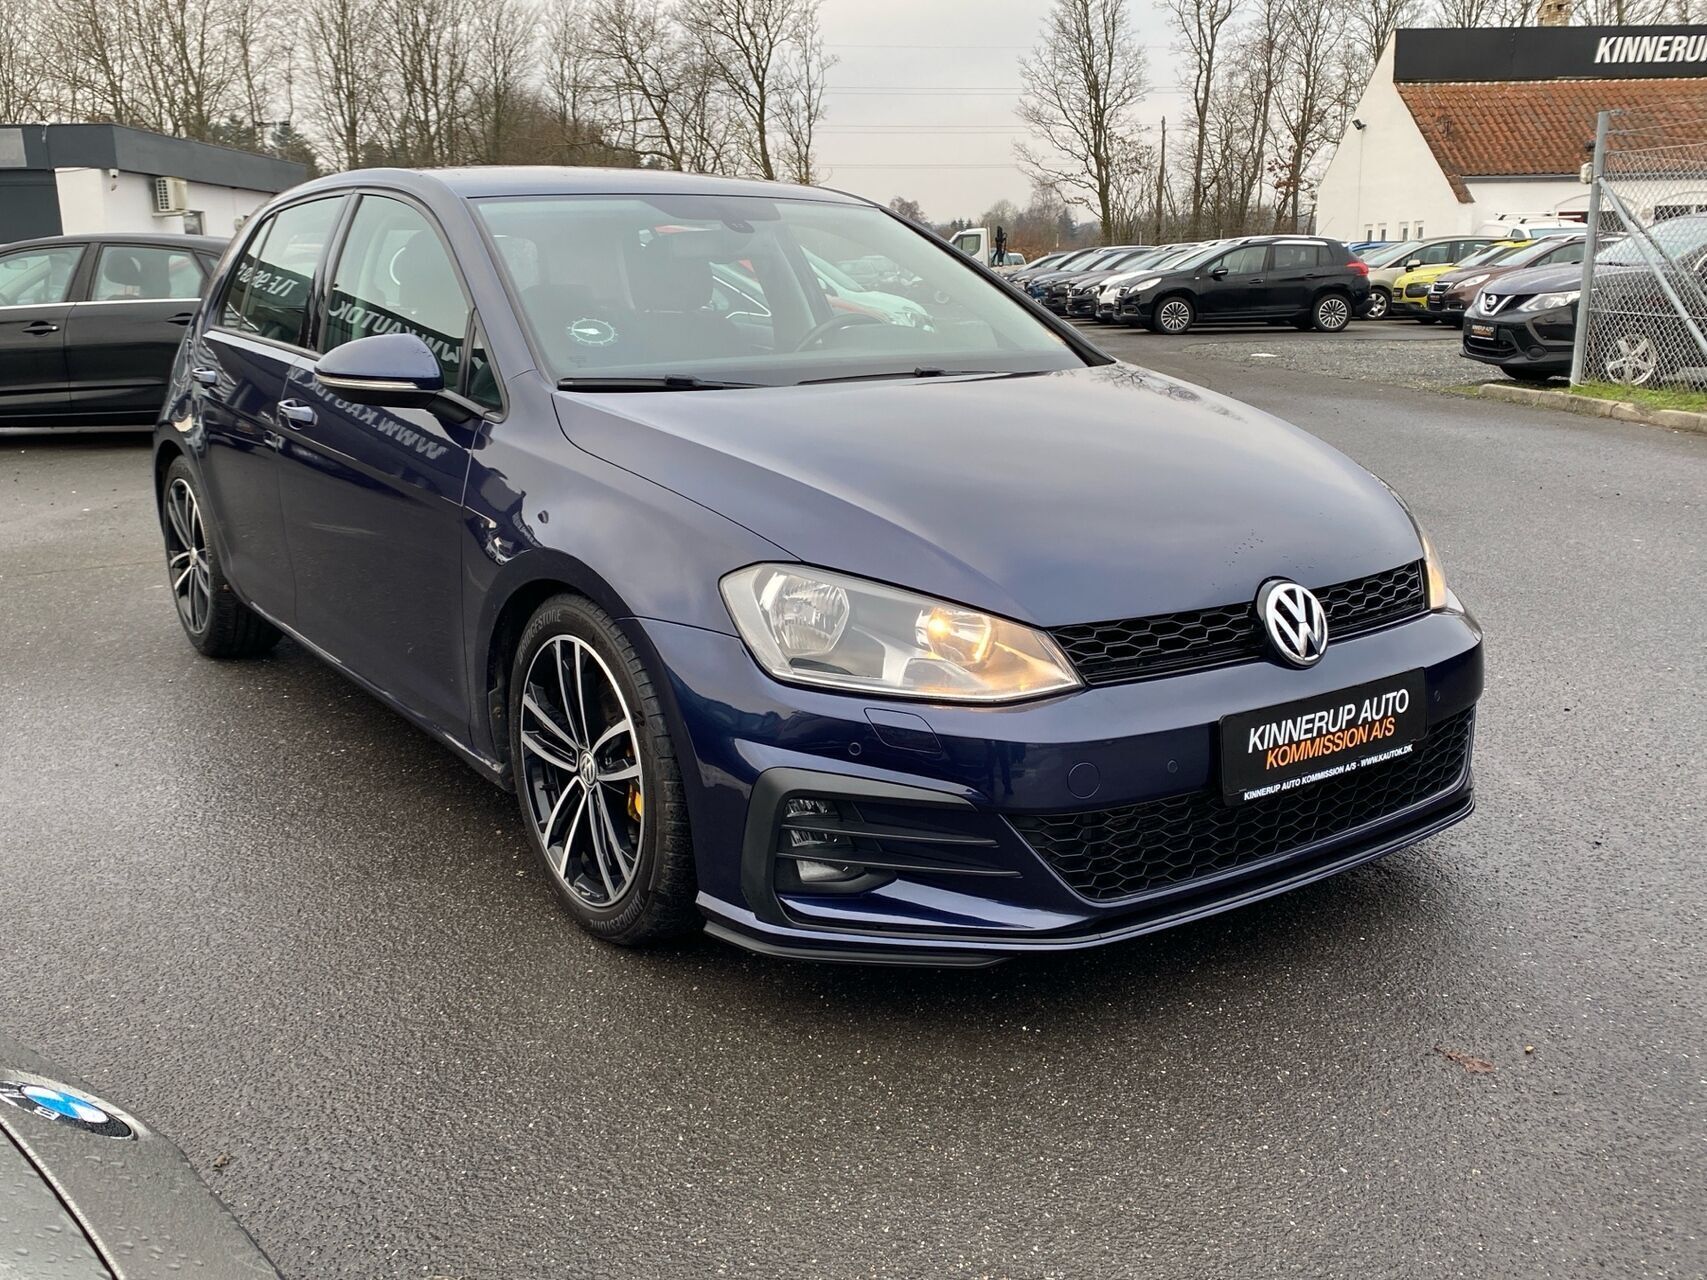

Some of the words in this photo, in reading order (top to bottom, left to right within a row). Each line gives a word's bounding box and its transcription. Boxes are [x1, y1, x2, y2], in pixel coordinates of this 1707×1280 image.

[1248, 703, 1355, 753] KINNERUP
[1357, 689, 1409, 725] AUTO
[1266, 725, 1369, 770] KOMMISSION
[1370, 717, 1396, 742] A/S
[1243, 784, 1280, 800] KINNERUP
[1281, 777, 1300, 792] AUTO
[1301, 765, 1345, 785] KOMMISSION
[1345, 761, 1357, 773] A/S
[1360, 744, 1413, 767] WWW.KAUTOK.DK
